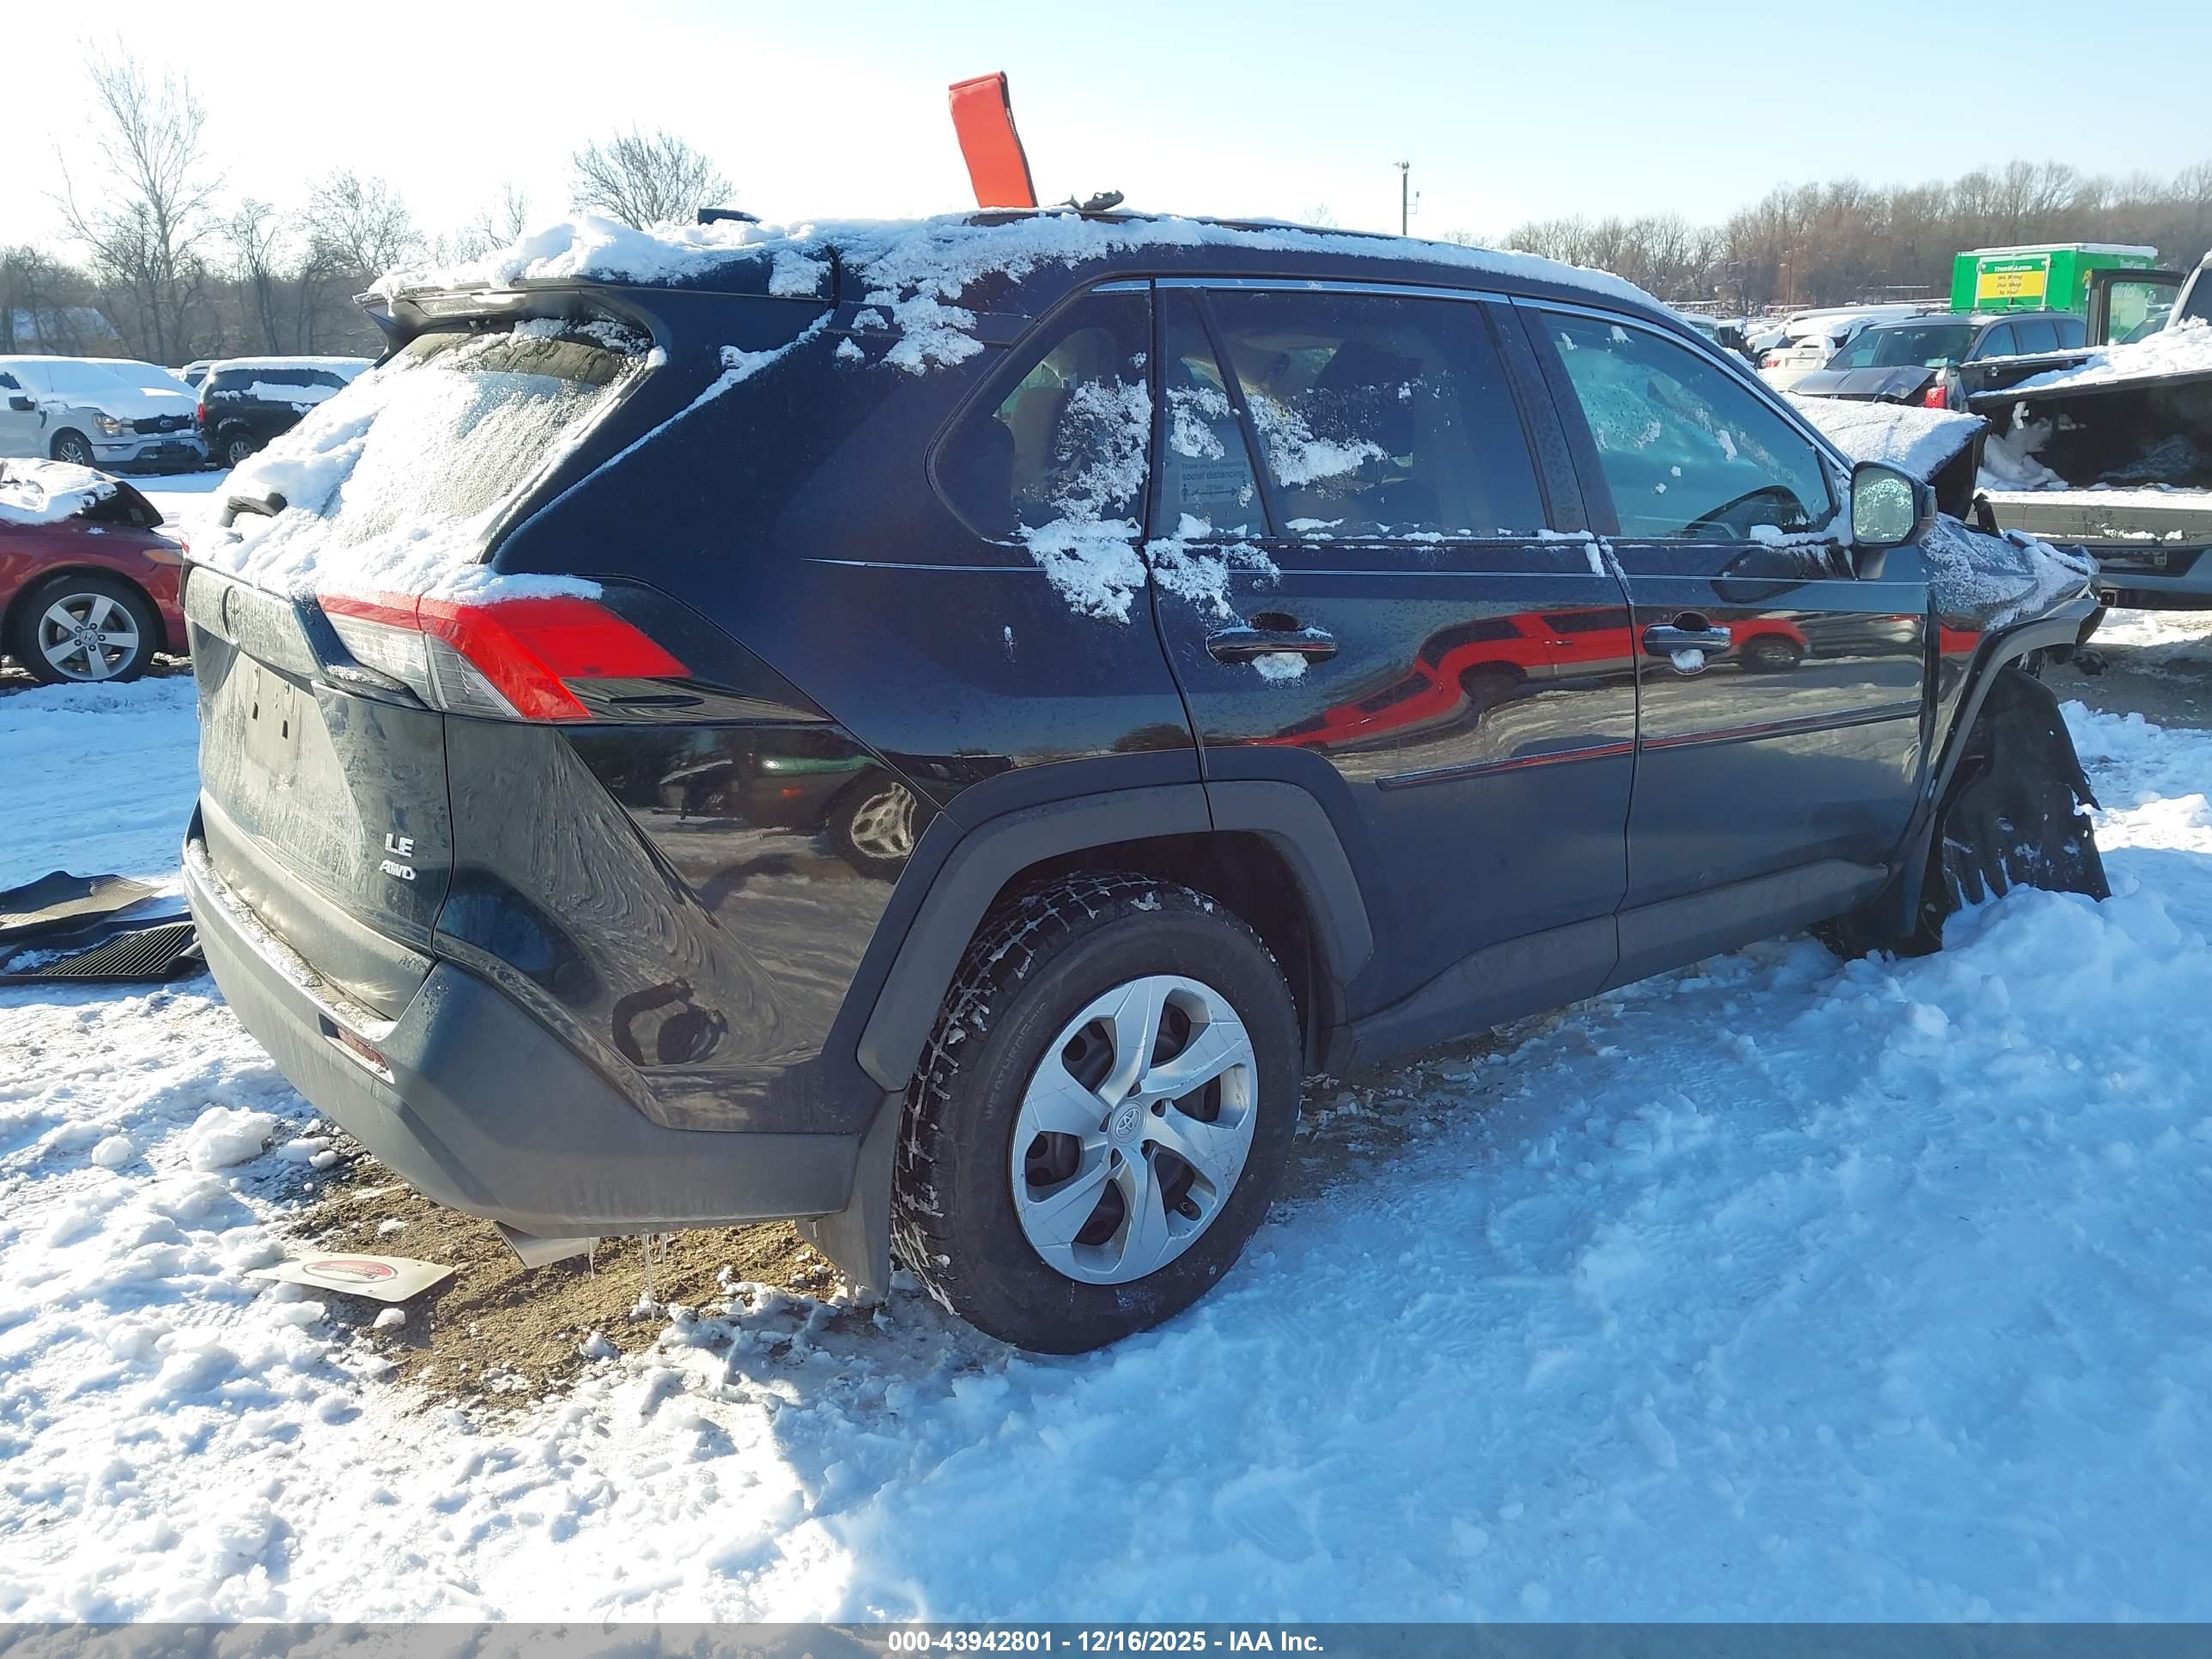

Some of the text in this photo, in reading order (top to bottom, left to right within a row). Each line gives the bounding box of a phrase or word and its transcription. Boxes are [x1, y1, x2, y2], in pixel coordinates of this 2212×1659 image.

[1182, 471, 1205, 481] social
[385, 833, 414, 857] LE
[379, 860, 416, 880] AWD
